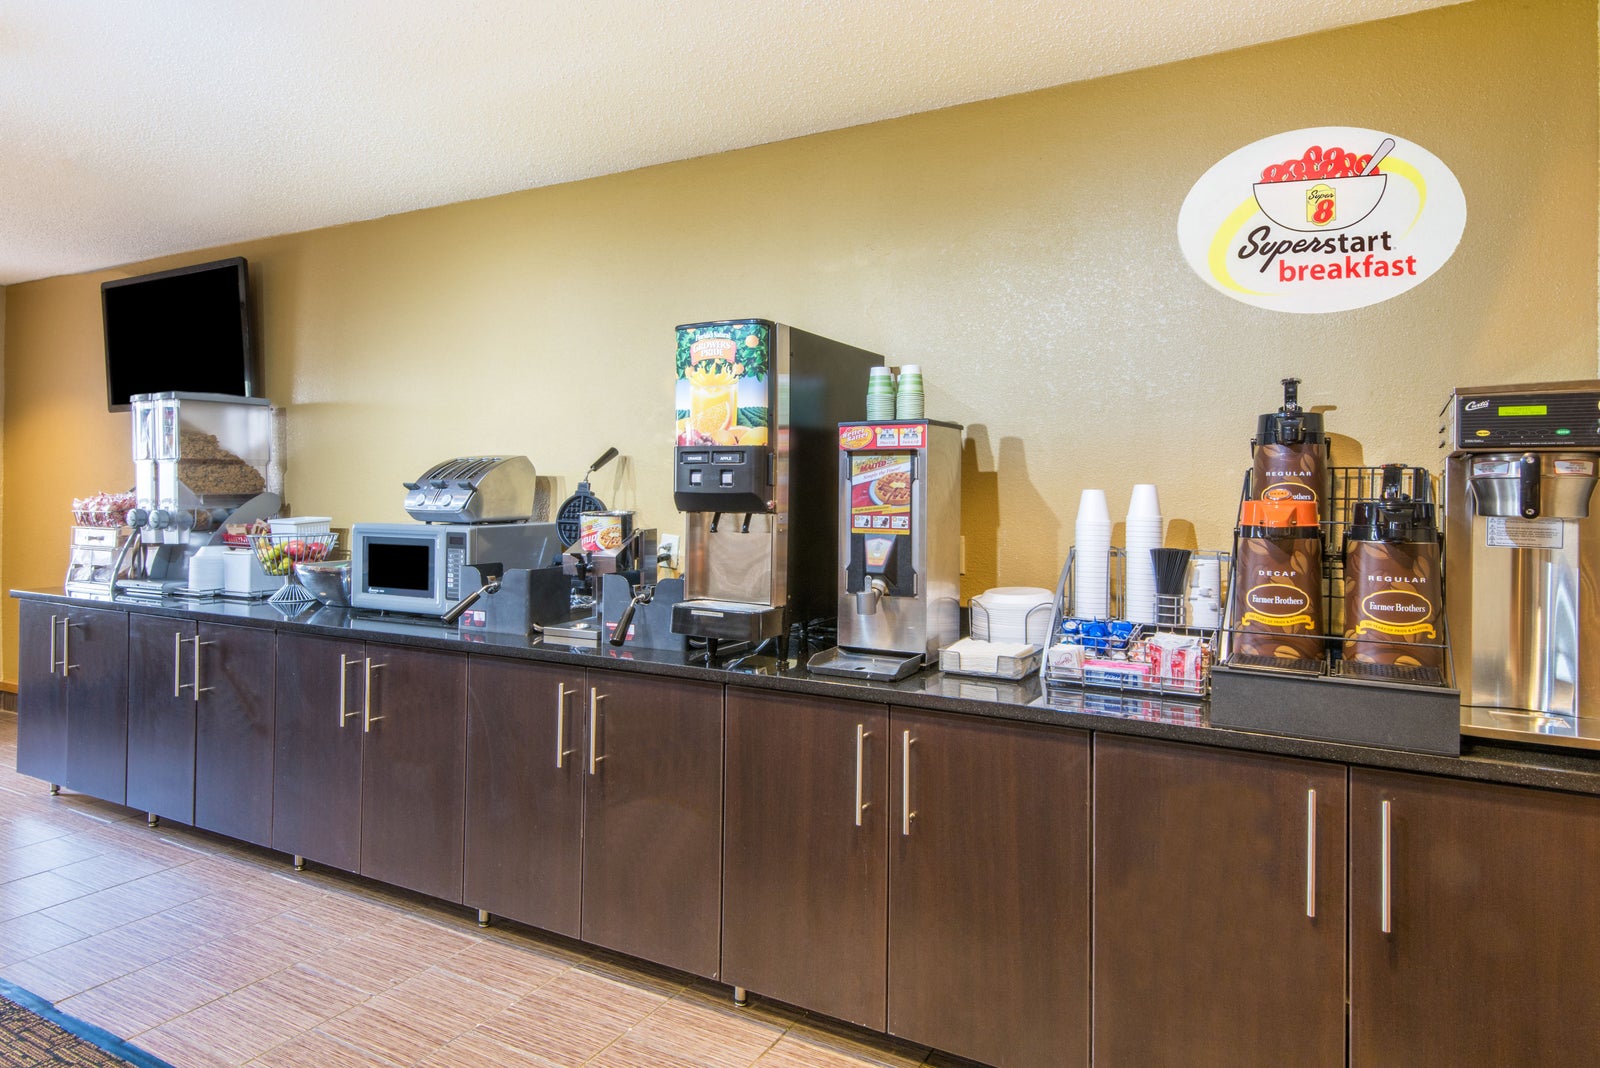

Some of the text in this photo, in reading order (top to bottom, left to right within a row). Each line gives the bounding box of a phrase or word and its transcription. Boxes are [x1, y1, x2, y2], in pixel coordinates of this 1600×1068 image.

[1308, 190, 1334, 203] Super
[1313, 199, 1334, 224] 8
[1238, 226, 1392, 273] Superstart
[1279, 254, 1417, 282] breakfast
[701, 348, 723, 357] PRIDE
[860, 460, 887, 472] MALTED
[1368, 575, 1427, 583] REGULAR
[1252, 594, 1304, 605] Farmer Brothers
[1369, 601, 1426, 613] Farmer Brothers
